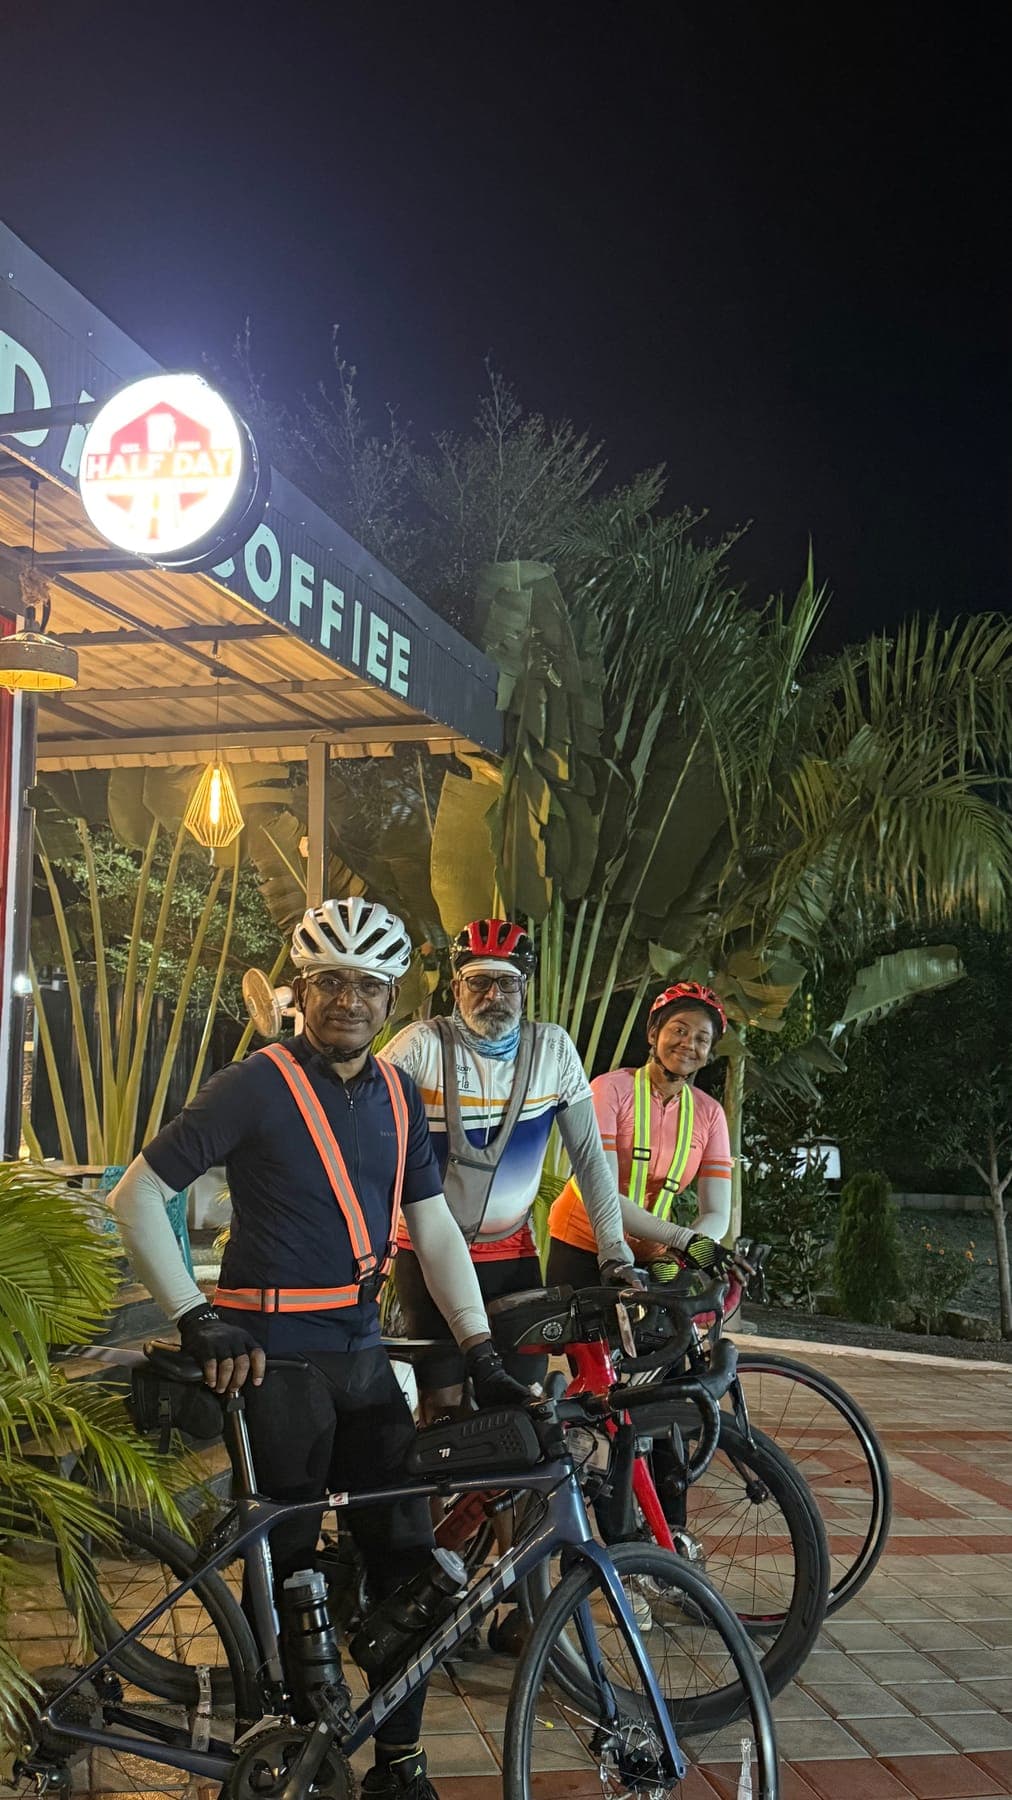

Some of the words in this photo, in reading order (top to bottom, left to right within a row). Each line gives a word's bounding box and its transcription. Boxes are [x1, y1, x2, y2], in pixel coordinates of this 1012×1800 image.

[87, 452, 165, 480] HALF
[173, 449, 232, 477] DAY
[212, 523, 410, 697] OFFIEE
